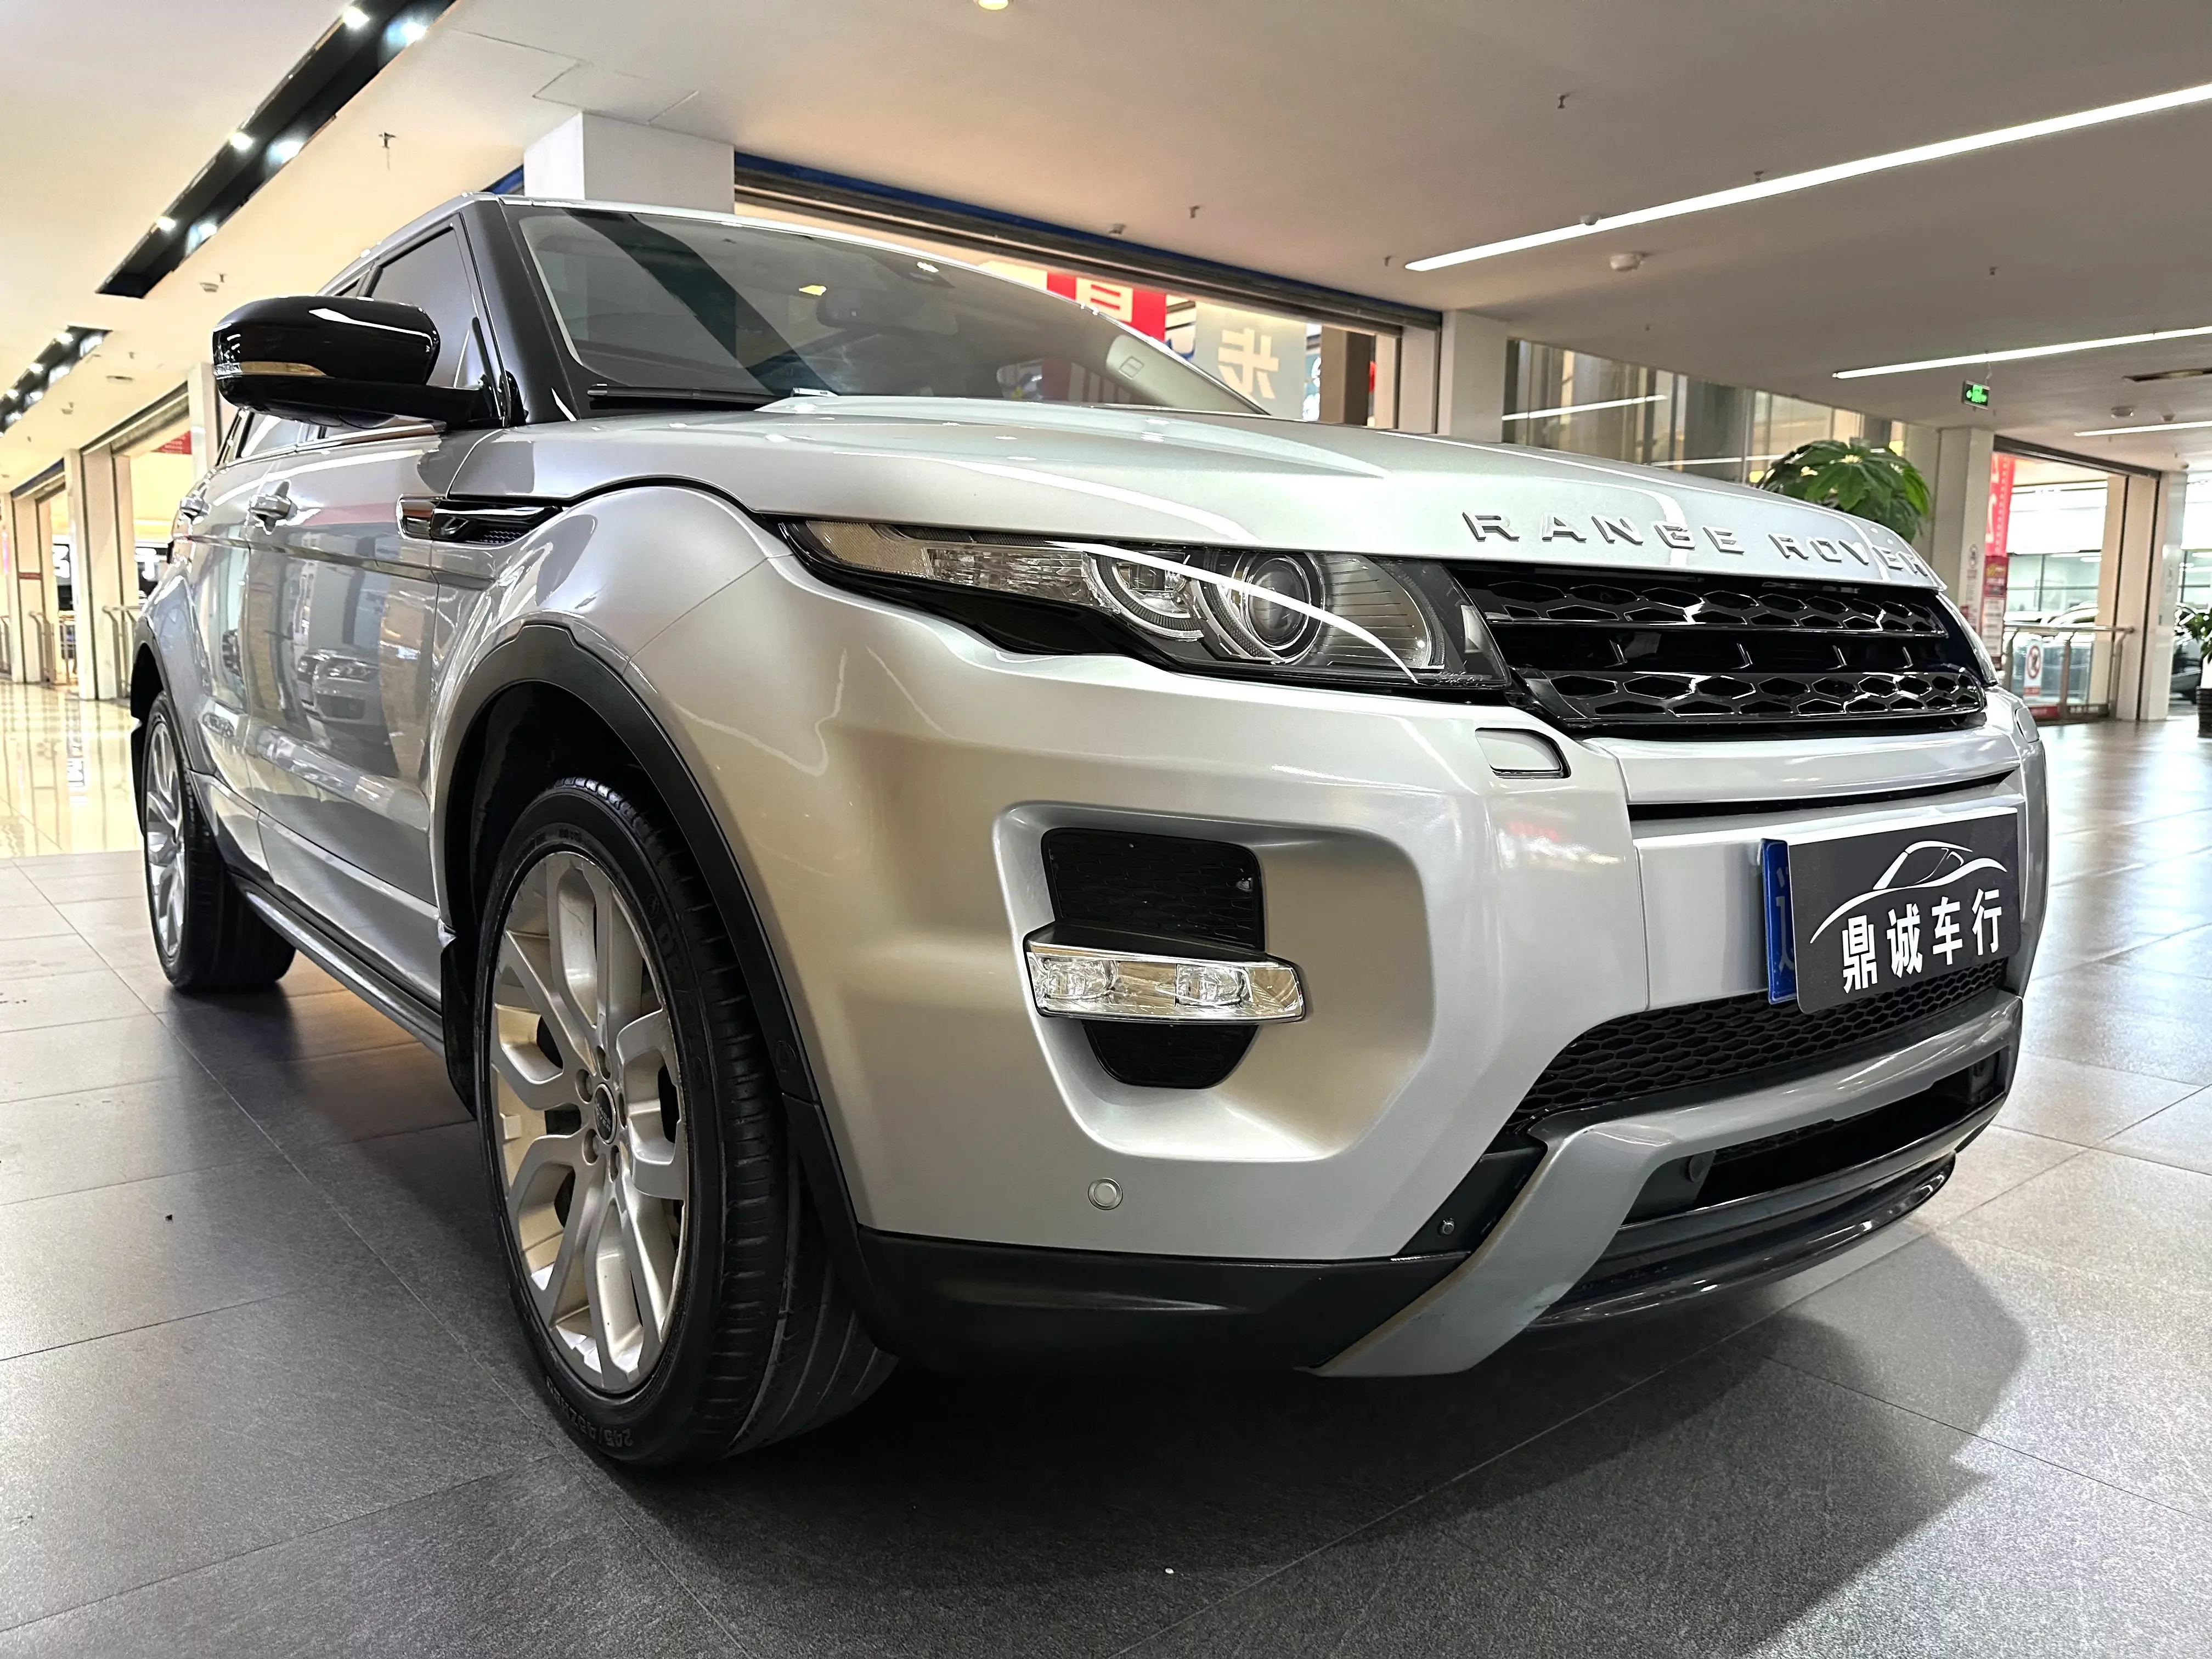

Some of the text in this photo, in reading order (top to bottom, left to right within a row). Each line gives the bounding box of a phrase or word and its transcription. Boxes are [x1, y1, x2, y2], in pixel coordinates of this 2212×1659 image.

[1462, 511, 1929, 577] RANGE ROVER
[1841, 888, 2003, 994] 鼎诚车行
